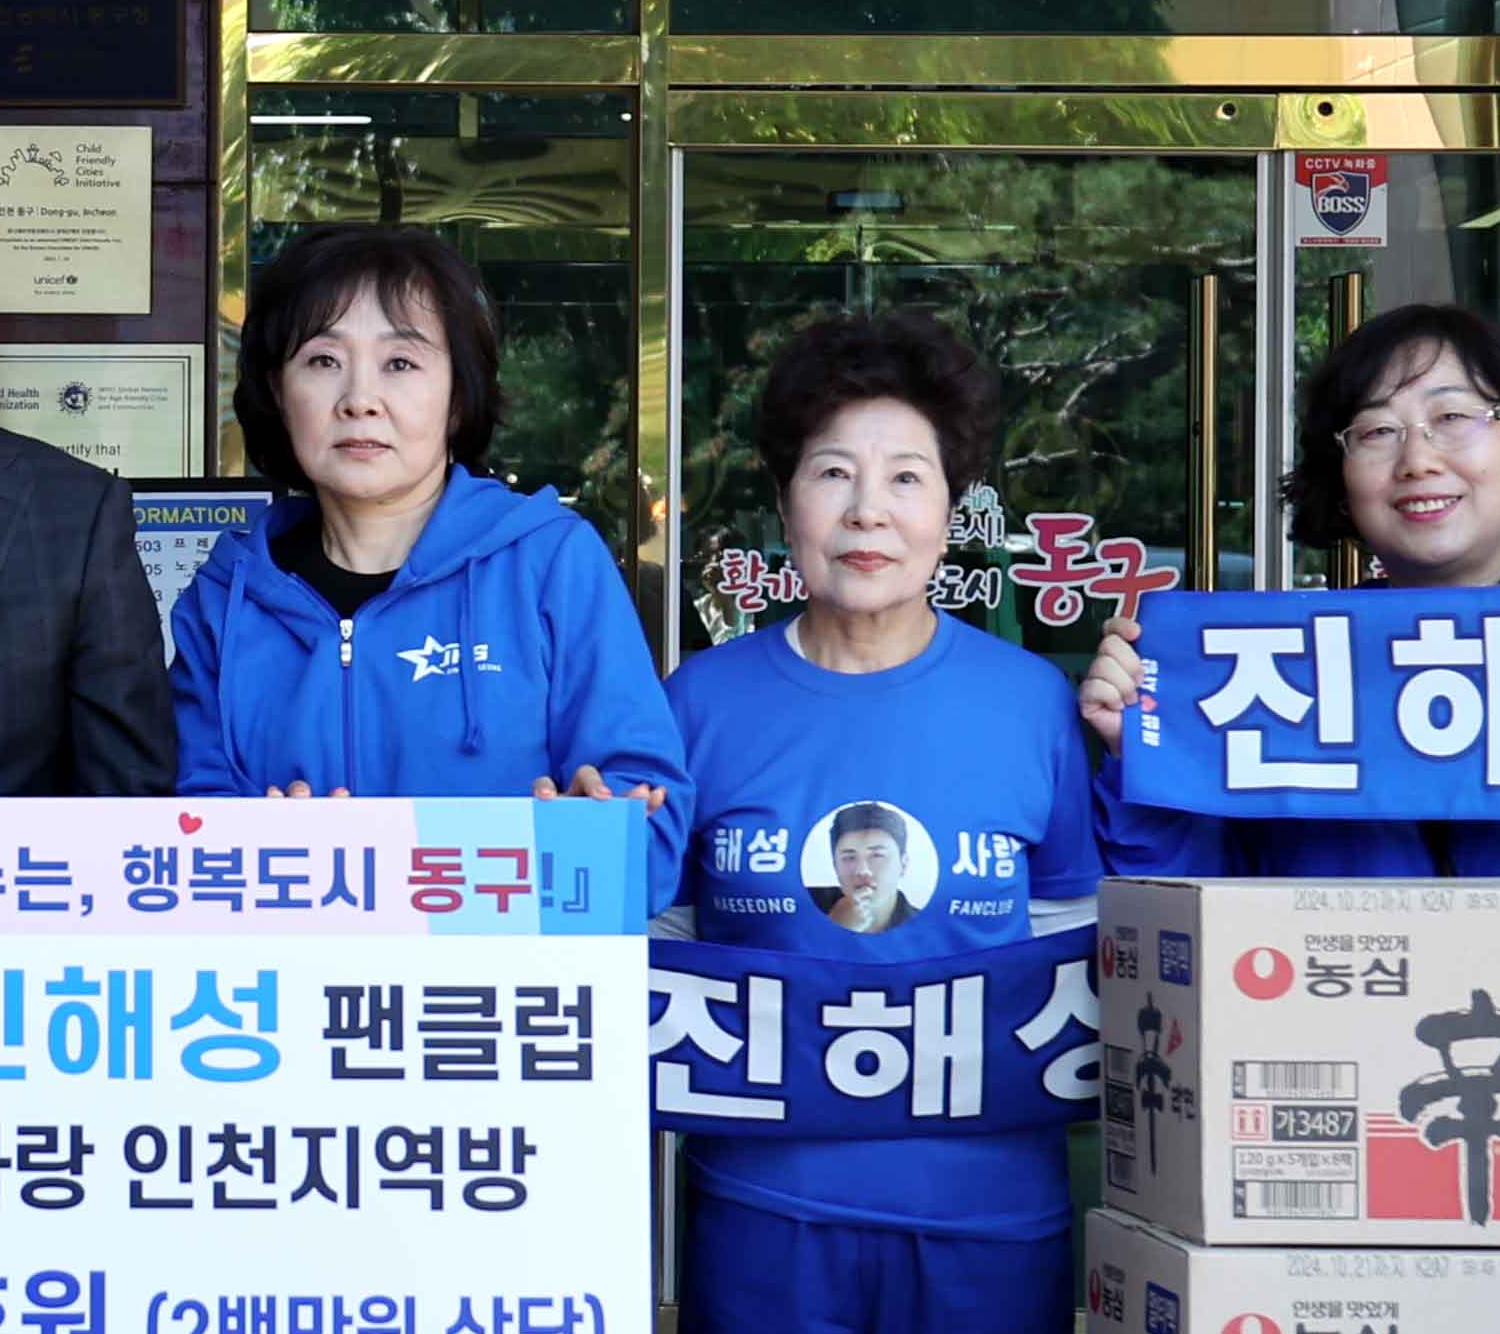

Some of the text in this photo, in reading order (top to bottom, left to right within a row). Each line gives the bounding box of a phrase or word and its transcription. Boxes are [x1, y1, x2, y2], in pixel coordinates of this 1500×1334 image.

[76, 144, 102, 153] Child
[76, 155, 116, 166] Friendly
[1305, 158, 1340, 168] CCTV
[76, 167, 103, 176] Cities
[76, 178, 121, 187] Initiative
[1318, 197, 1365, 213] BOSS
[33, 275, 64, 284] unicef
[8, 387, 39, 398] Health
[57, 444, 121, 457] rtify that
[133, 507, 246, 523] ORMATION
[145, 564, 162, 575] 05
[718, 512, 1180, 626] 활기 도시 동구
[714, 828, 1022, 878] 해성 사랑
[121, 843, 378, 914] 행복도시
[949, 898, 1013, 916] FANCLUB
[1304, 958, 1409, 998] 농심
[322, 984, 595, 1082] 팬클럽
[122, 1123, 538, 1212] 인천지역방
